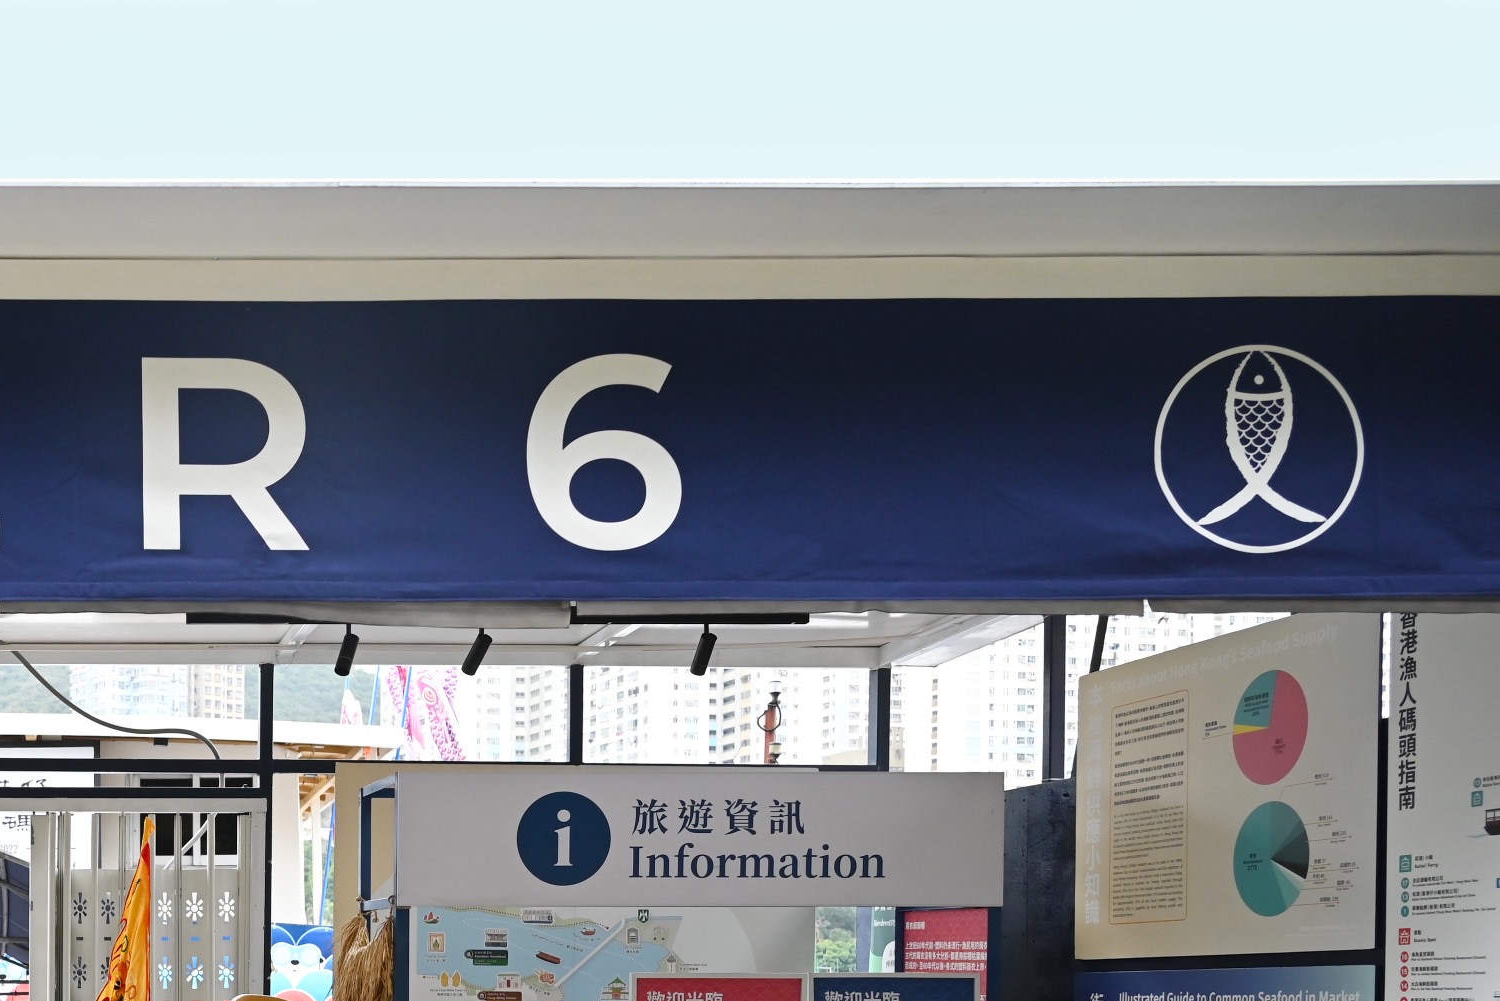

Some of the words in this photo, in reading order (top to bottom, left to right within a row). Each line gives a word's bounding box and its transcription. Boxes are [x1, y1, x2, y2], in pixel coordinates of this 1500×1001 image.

[526, 353, 681, 551] 6
[1111, 680, 1137, 694] Facts
[1137, 671, 1167, 687] about
[1170, 665, 1200, 681] Hong
[1240, 634, 1289, 662] Seafood
[1293, 624, 1337, 648] Supply
[1399, 613, 1417, 811] 香港漁人碼頭指南
[631, 798, 806, 836] 旅遊資訊
[628, 844, 885, 879] Information
